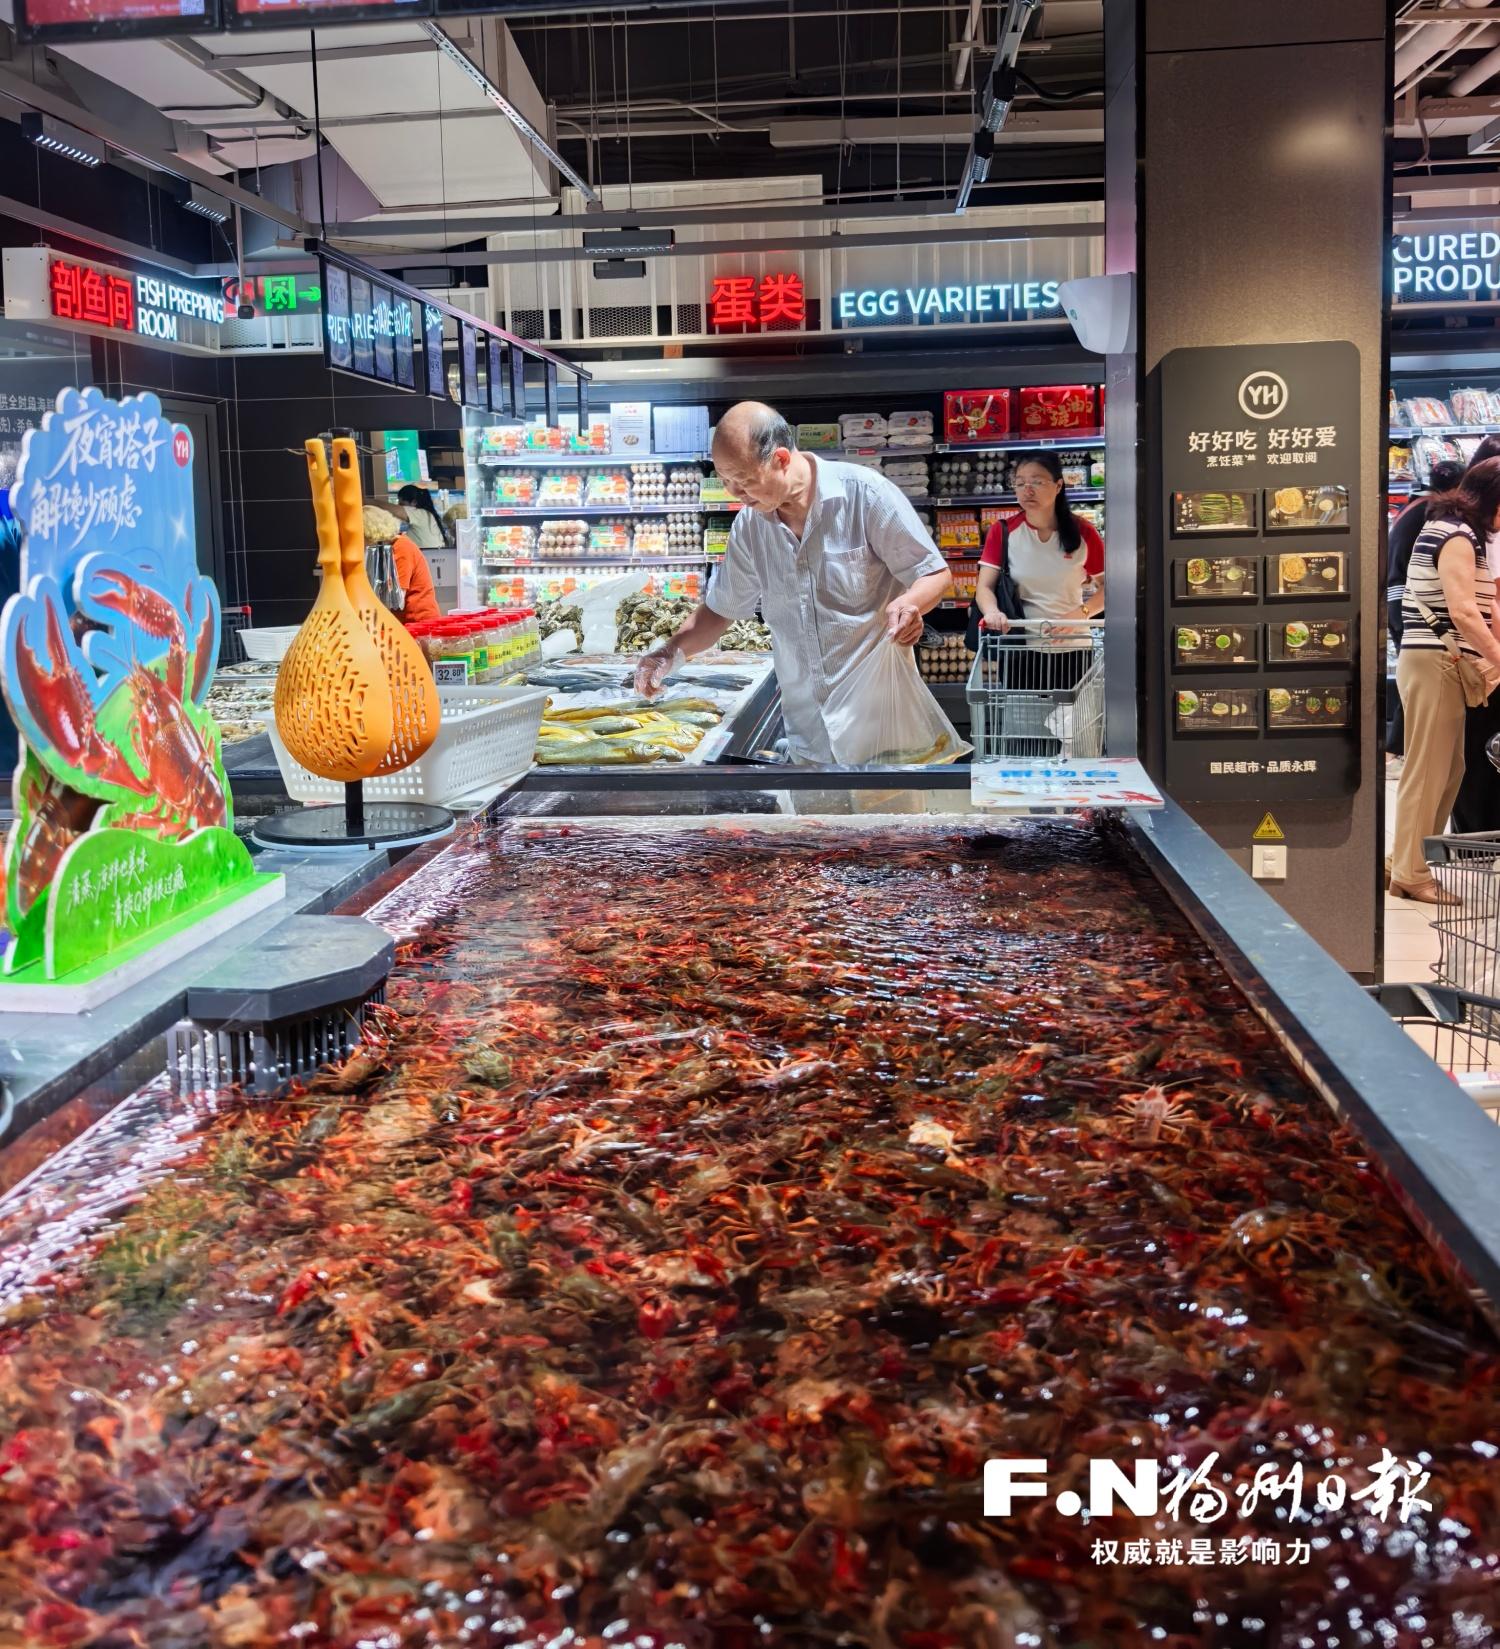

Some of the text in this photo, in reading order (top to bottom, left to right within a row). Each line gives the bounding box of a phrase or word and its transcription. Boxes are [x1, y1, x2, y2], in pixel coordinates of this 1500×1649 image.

[1392, 232, 1500, 263] CURED
[52, 261, 134, 329] 剖鱼间
[137, 275, 225, 325] FISH PREPPING
[711, 273, 806, 324] 蛋类
[839, 281, 1060, 318] EGG VARIETIES
[137, 307, 178, 341] ROOM
[1248, 385, 1280, 406] YH
[45, 408, 168, 480] 夜宵搭子
[174, 437, 190, 459] YH
[1188, 426, 1337, 453] 好好吃 好好爱
[1266, 452, 1318, 465] 欢迎取阅
[1210, 760, 1317, 774] 国民超市·品质永辉
